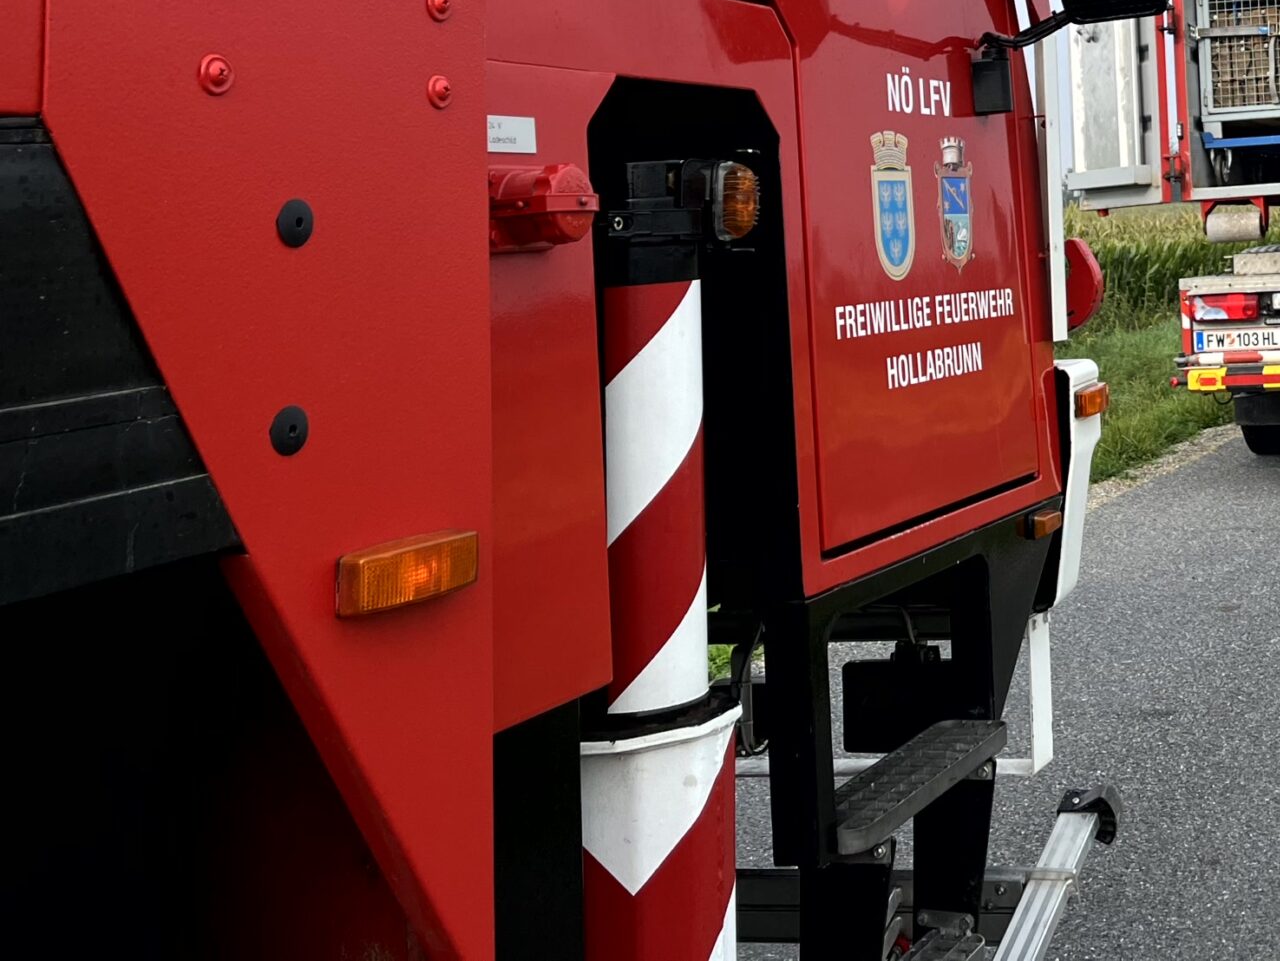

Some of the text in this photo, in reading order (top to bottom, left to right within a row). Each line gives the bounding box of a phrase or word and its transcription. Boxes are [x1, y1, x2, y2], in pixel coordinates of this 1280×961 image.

[886, 66, 950, 117] NÖ LFV
[835, 288, 1014, 340] FREIWILLIGE FEUERWEHR
[1206, 331, 1278, 348] FW 103 HL
[886, 342, 982, 389] HOLLABRUNN
